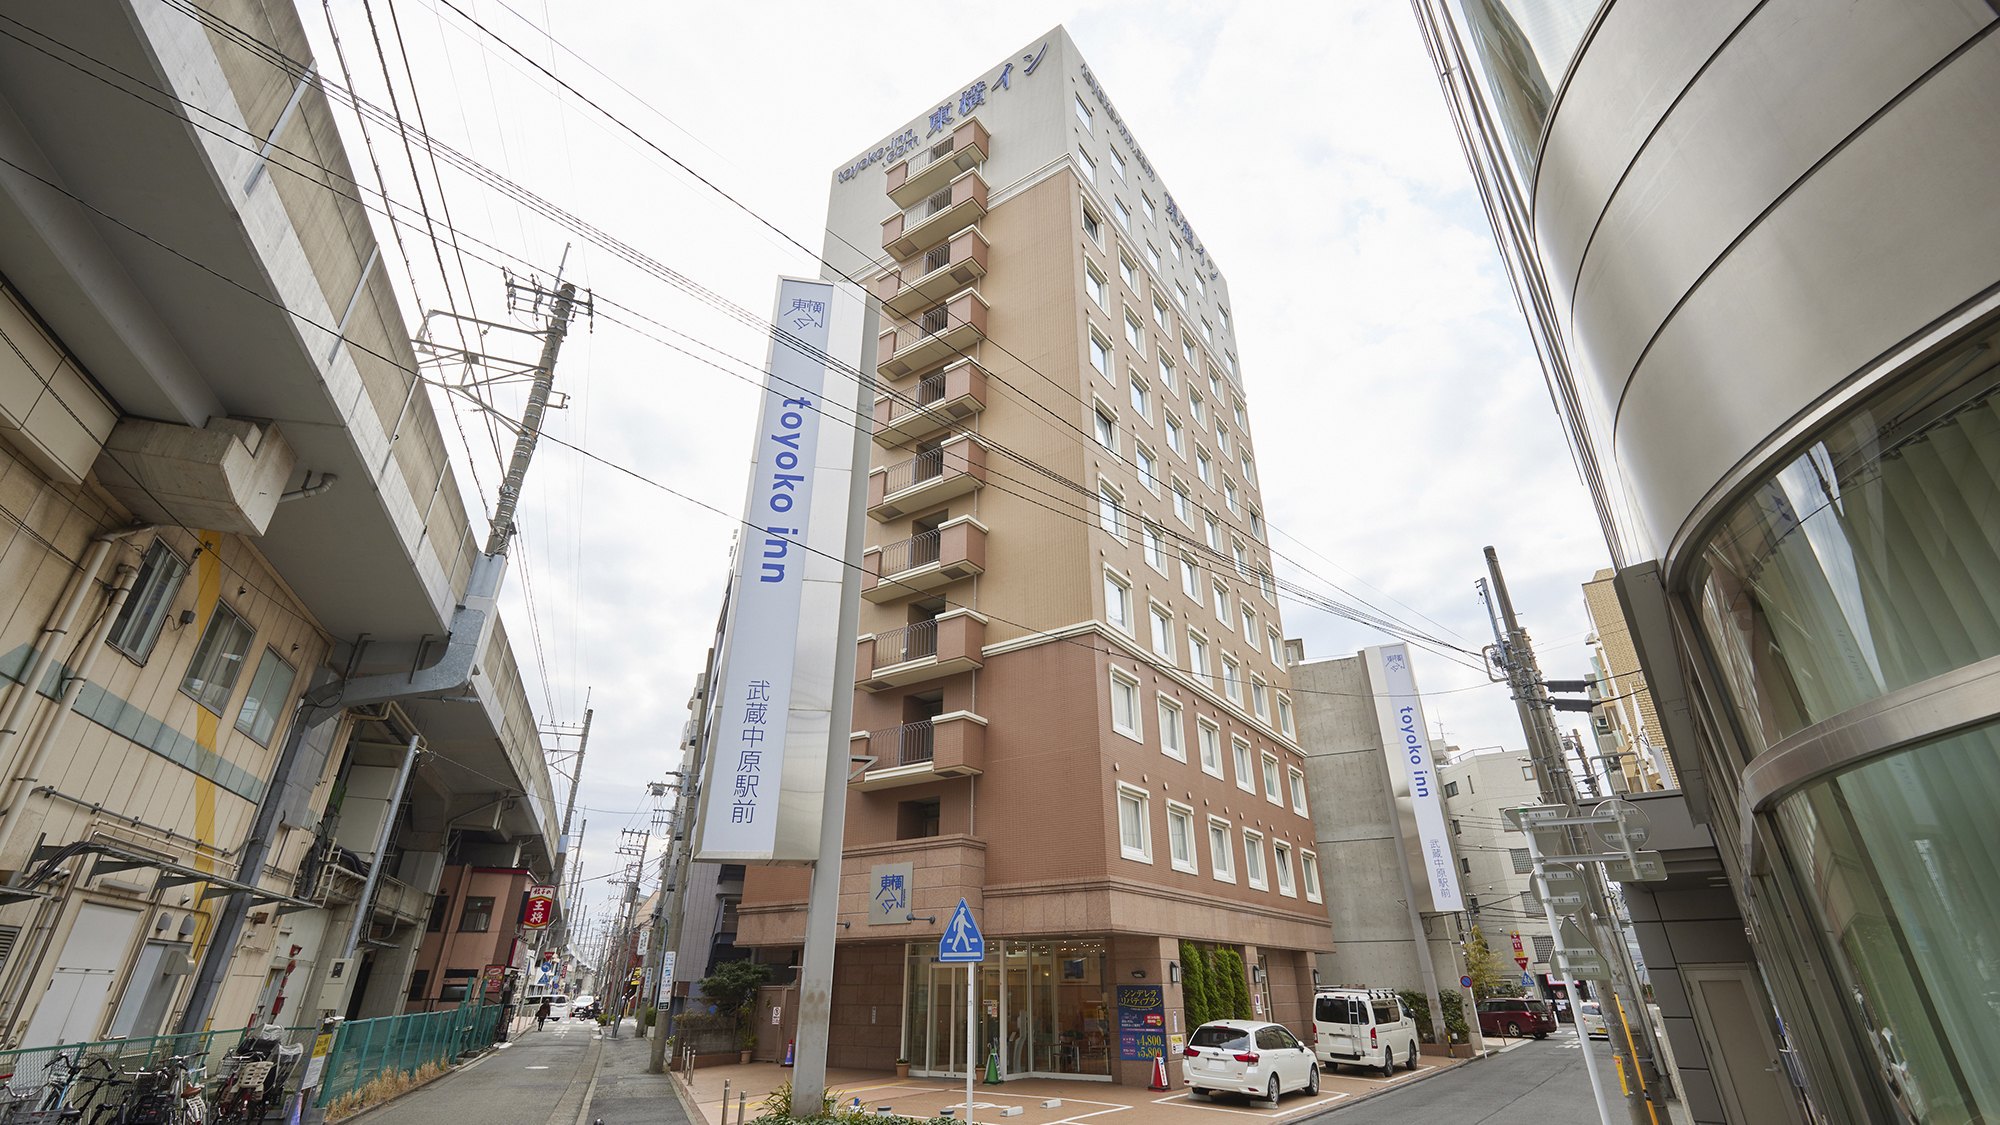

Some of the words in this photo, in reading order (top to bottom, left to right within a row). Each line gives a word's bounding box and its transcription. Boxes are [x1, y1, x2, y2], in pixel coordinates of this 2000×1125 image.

[926, 41, 1049, 139] 東横イン
[837, 128, 914, 184] toyoko-inn
[770, 396, 813, 513] toyoko
[759, 526, 799, 584] inn
[731, 679, 771, 824] 武蔵中原駅前
[1400, 706, 1423, 765] toyoko
[1413, 770, 1429, 798] inn
[1429, 839, 1451, 898] 武蔵中原駅前
[529, 900, 545, 923] 王将
[1124, 989, 1157, 998] シンデレラ
